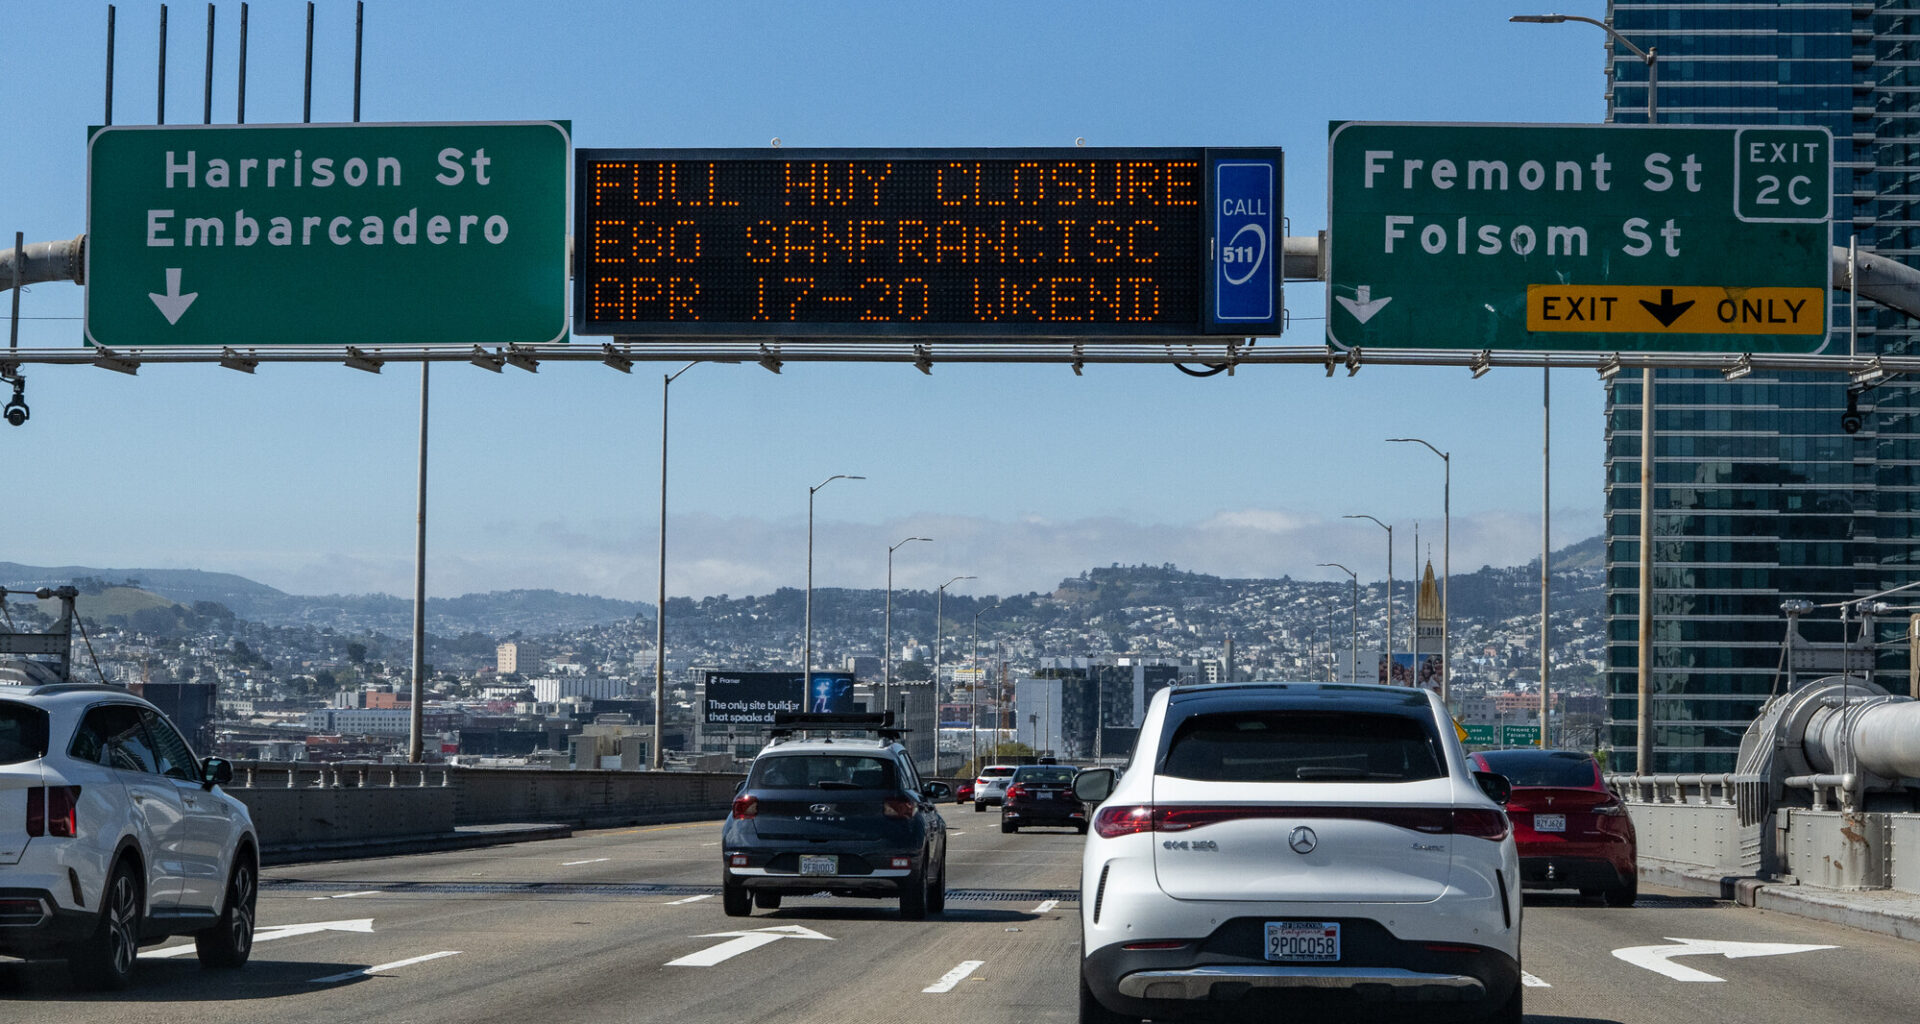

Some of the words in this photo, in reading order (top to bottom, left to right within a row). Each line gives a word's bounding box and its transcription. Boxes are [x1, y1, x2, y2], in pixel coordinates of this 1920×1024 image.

[167, 150, 400, 187] Harrison
[436, 148, 490, 185] St
[1751, 144, 1818, 162] EXIT
[596, 164, 739, 205] FULL
[786, 163, 891, 205] HWY
[937, 163, 1197, 205] CLOSURE
[1366, 151, 1610, 190] Fremont
[1645, 154, 1701, 191] St
[1757, 176, 1810, 204] 2C
[1223, 198, 1267, 216] CALL
[148, 208, 508, 246] Embarcadero
[596, 221, 700, 263] E80
[747, 220, 1158, 263] SANFRANCISC
[1386, 216, 1587, 255] Folsom
[1623, 218, 1680, 256] St
[1223, 246, 1254, 263] 511
[595, 278, 699, 319] APR
[753, 278, 928, 320] 17-20
[975, 278, 1158, 320] WKEND
[1543, 297, 1618, 321] EXIT
[1717, 296, 1806, 323] ONLY
[709, 700, 726, 710] The
[728, 700, 748, 712] only
[750, 700, 766, 710] site
[768, 700, 800, 710] builder
[709, 712, 728, 722] that
[730, 712, 762, 723] speaks
